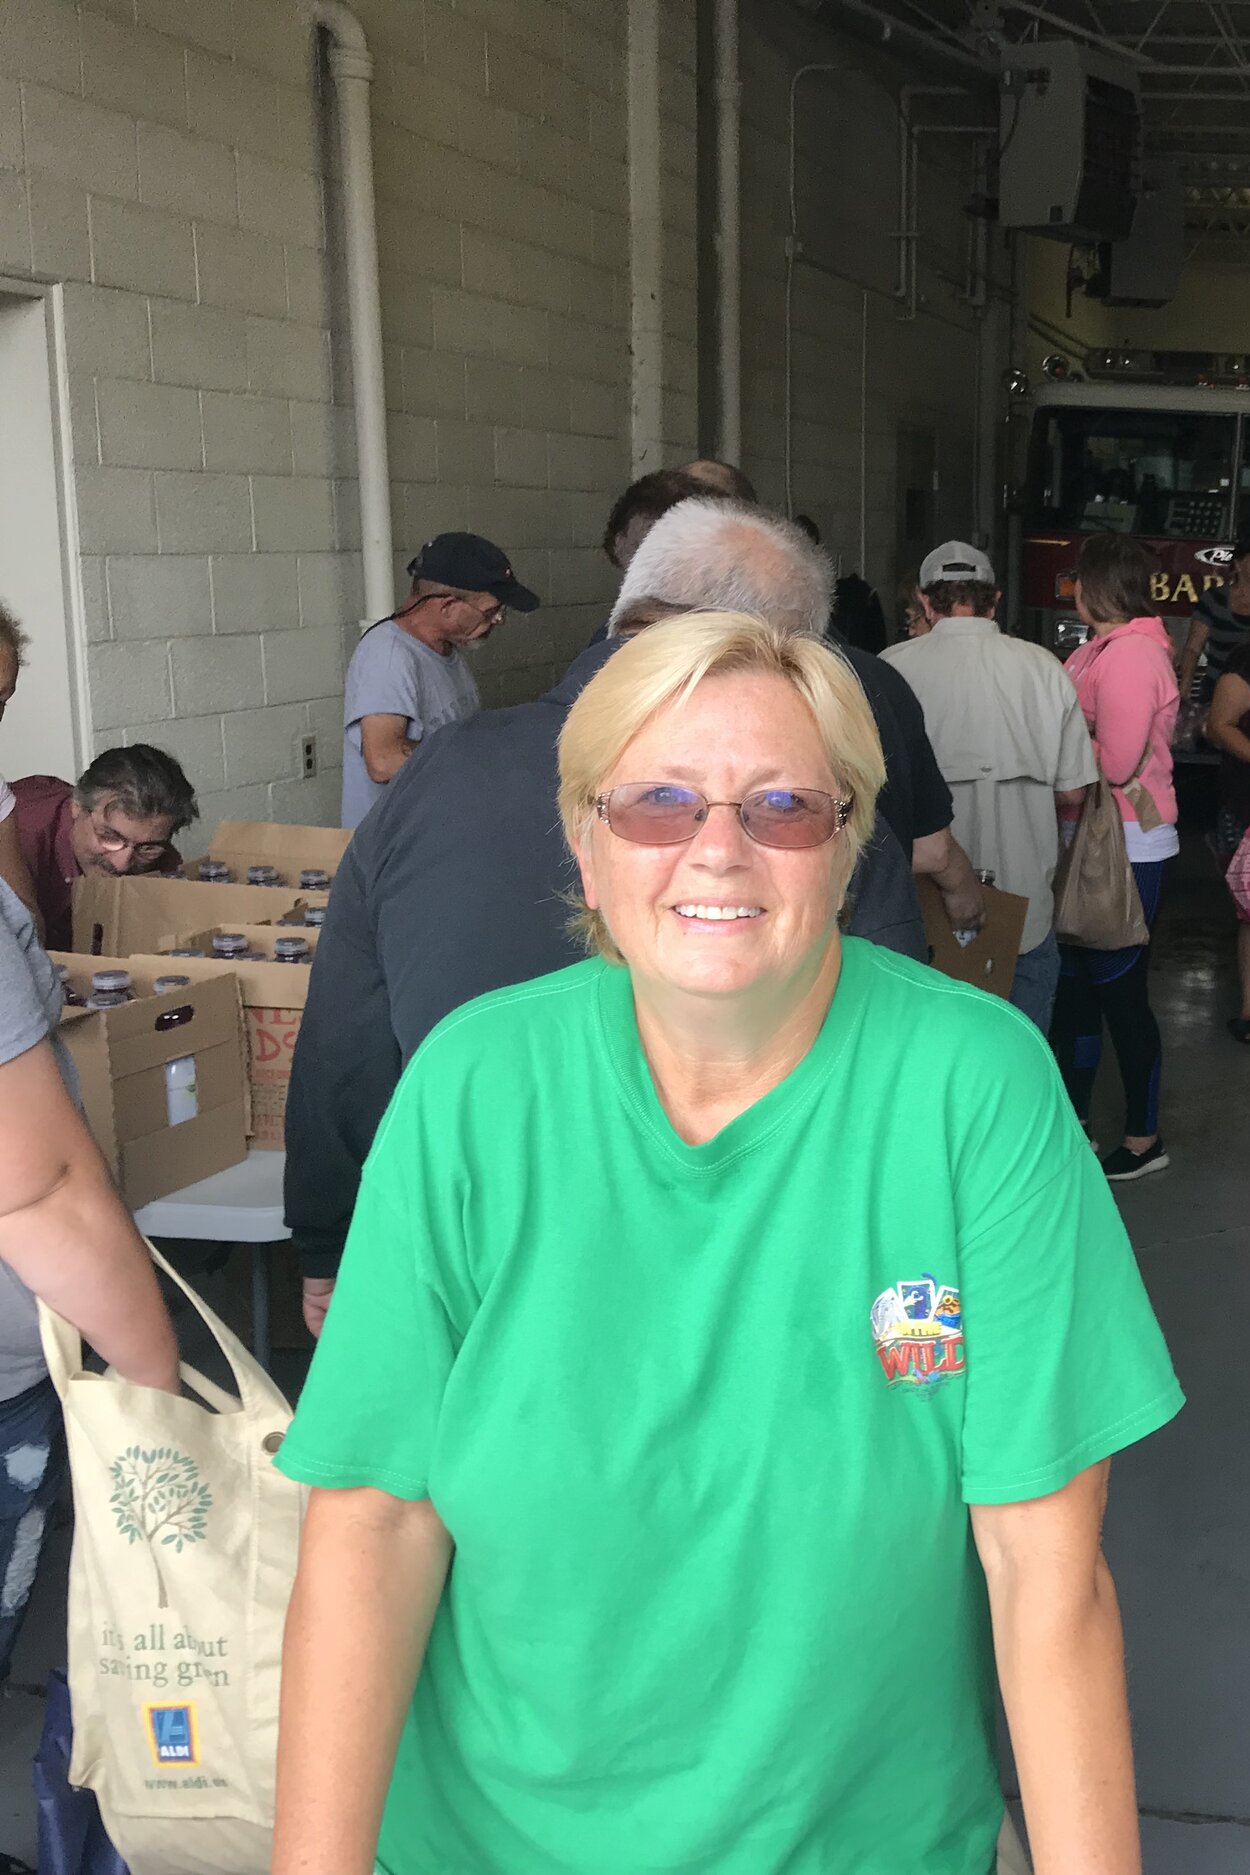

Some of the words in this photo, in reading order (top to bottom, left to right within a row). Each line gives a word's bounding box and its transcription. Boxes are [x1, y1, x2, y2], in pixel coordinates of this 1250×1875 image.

[877, 1336, 966, 1380] WILD
[134, 1624, 166, 1651] all
[160, 1746, 190, 1757] ALDI
